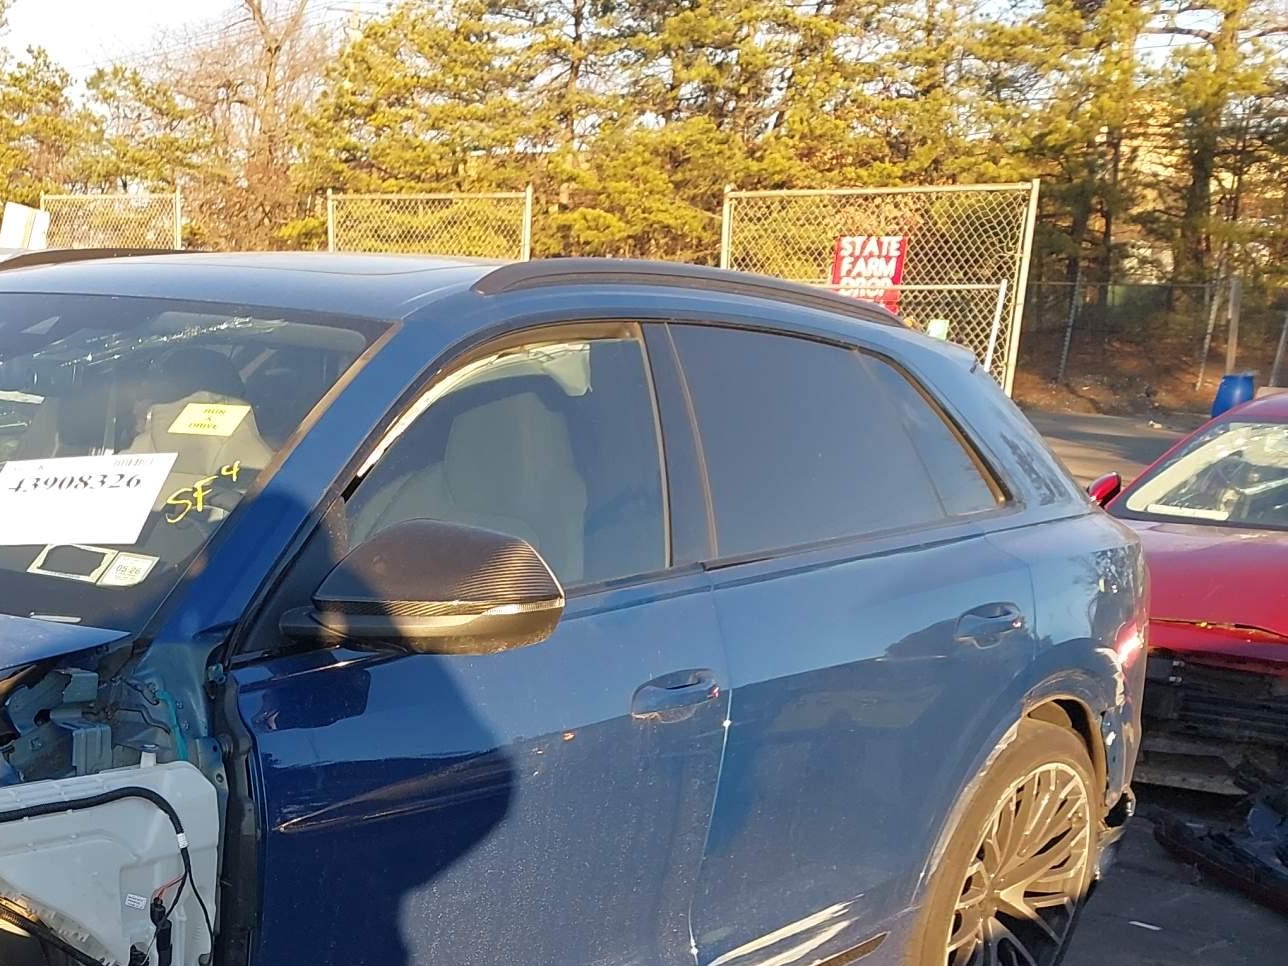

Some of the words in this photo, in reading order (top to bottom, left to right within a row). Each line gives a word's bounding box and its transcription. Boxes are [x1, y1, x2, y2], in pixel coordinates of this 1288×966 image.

[840, 236, 903, 256] STATE
[840, 257, 897, 277] FARM
[839, 277, 893, 297] DROP
[8, 473, 142, 493] 43908326
